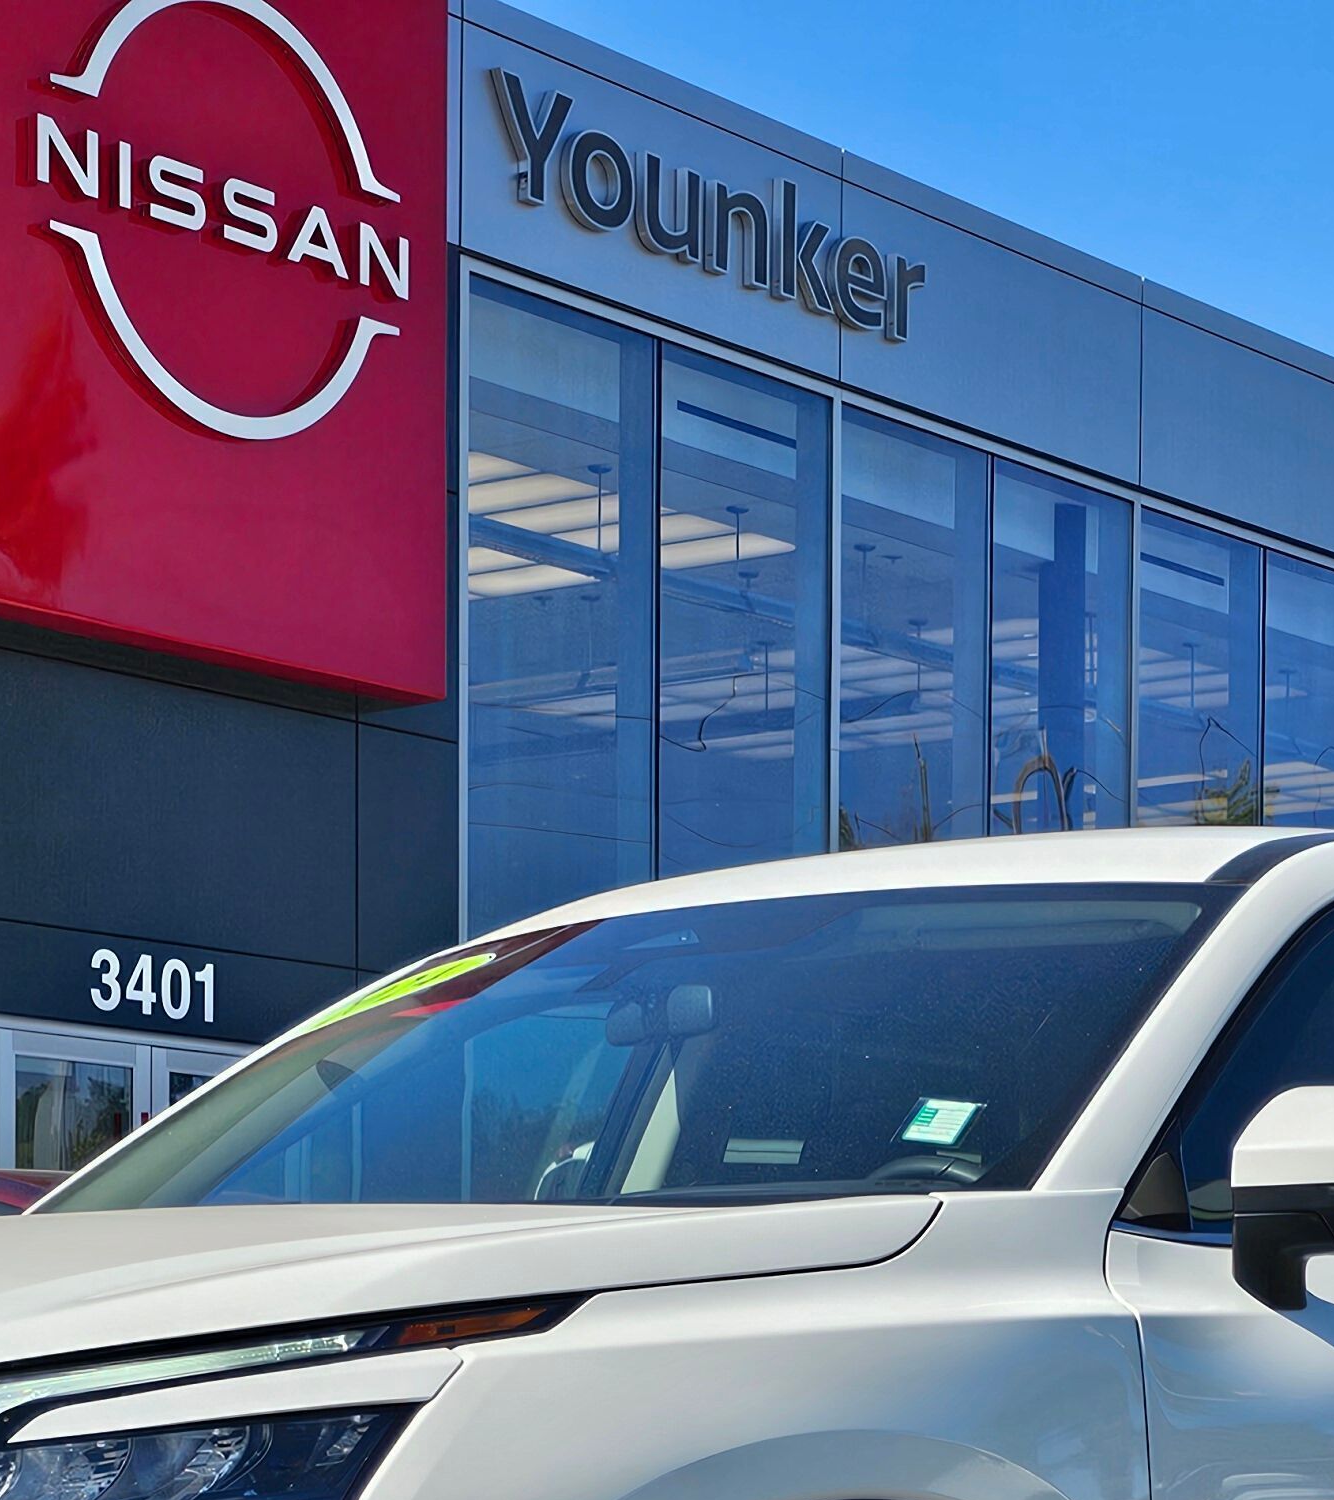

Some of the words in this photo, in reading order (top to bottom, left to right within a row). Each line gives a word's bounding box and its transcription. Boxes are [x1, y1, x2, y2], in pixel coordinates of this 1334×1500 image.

[36, 113, 411, 301] NISSAN
[489, 67, 927, 343] Younker
[90, 948, 216, 1023] 3401
